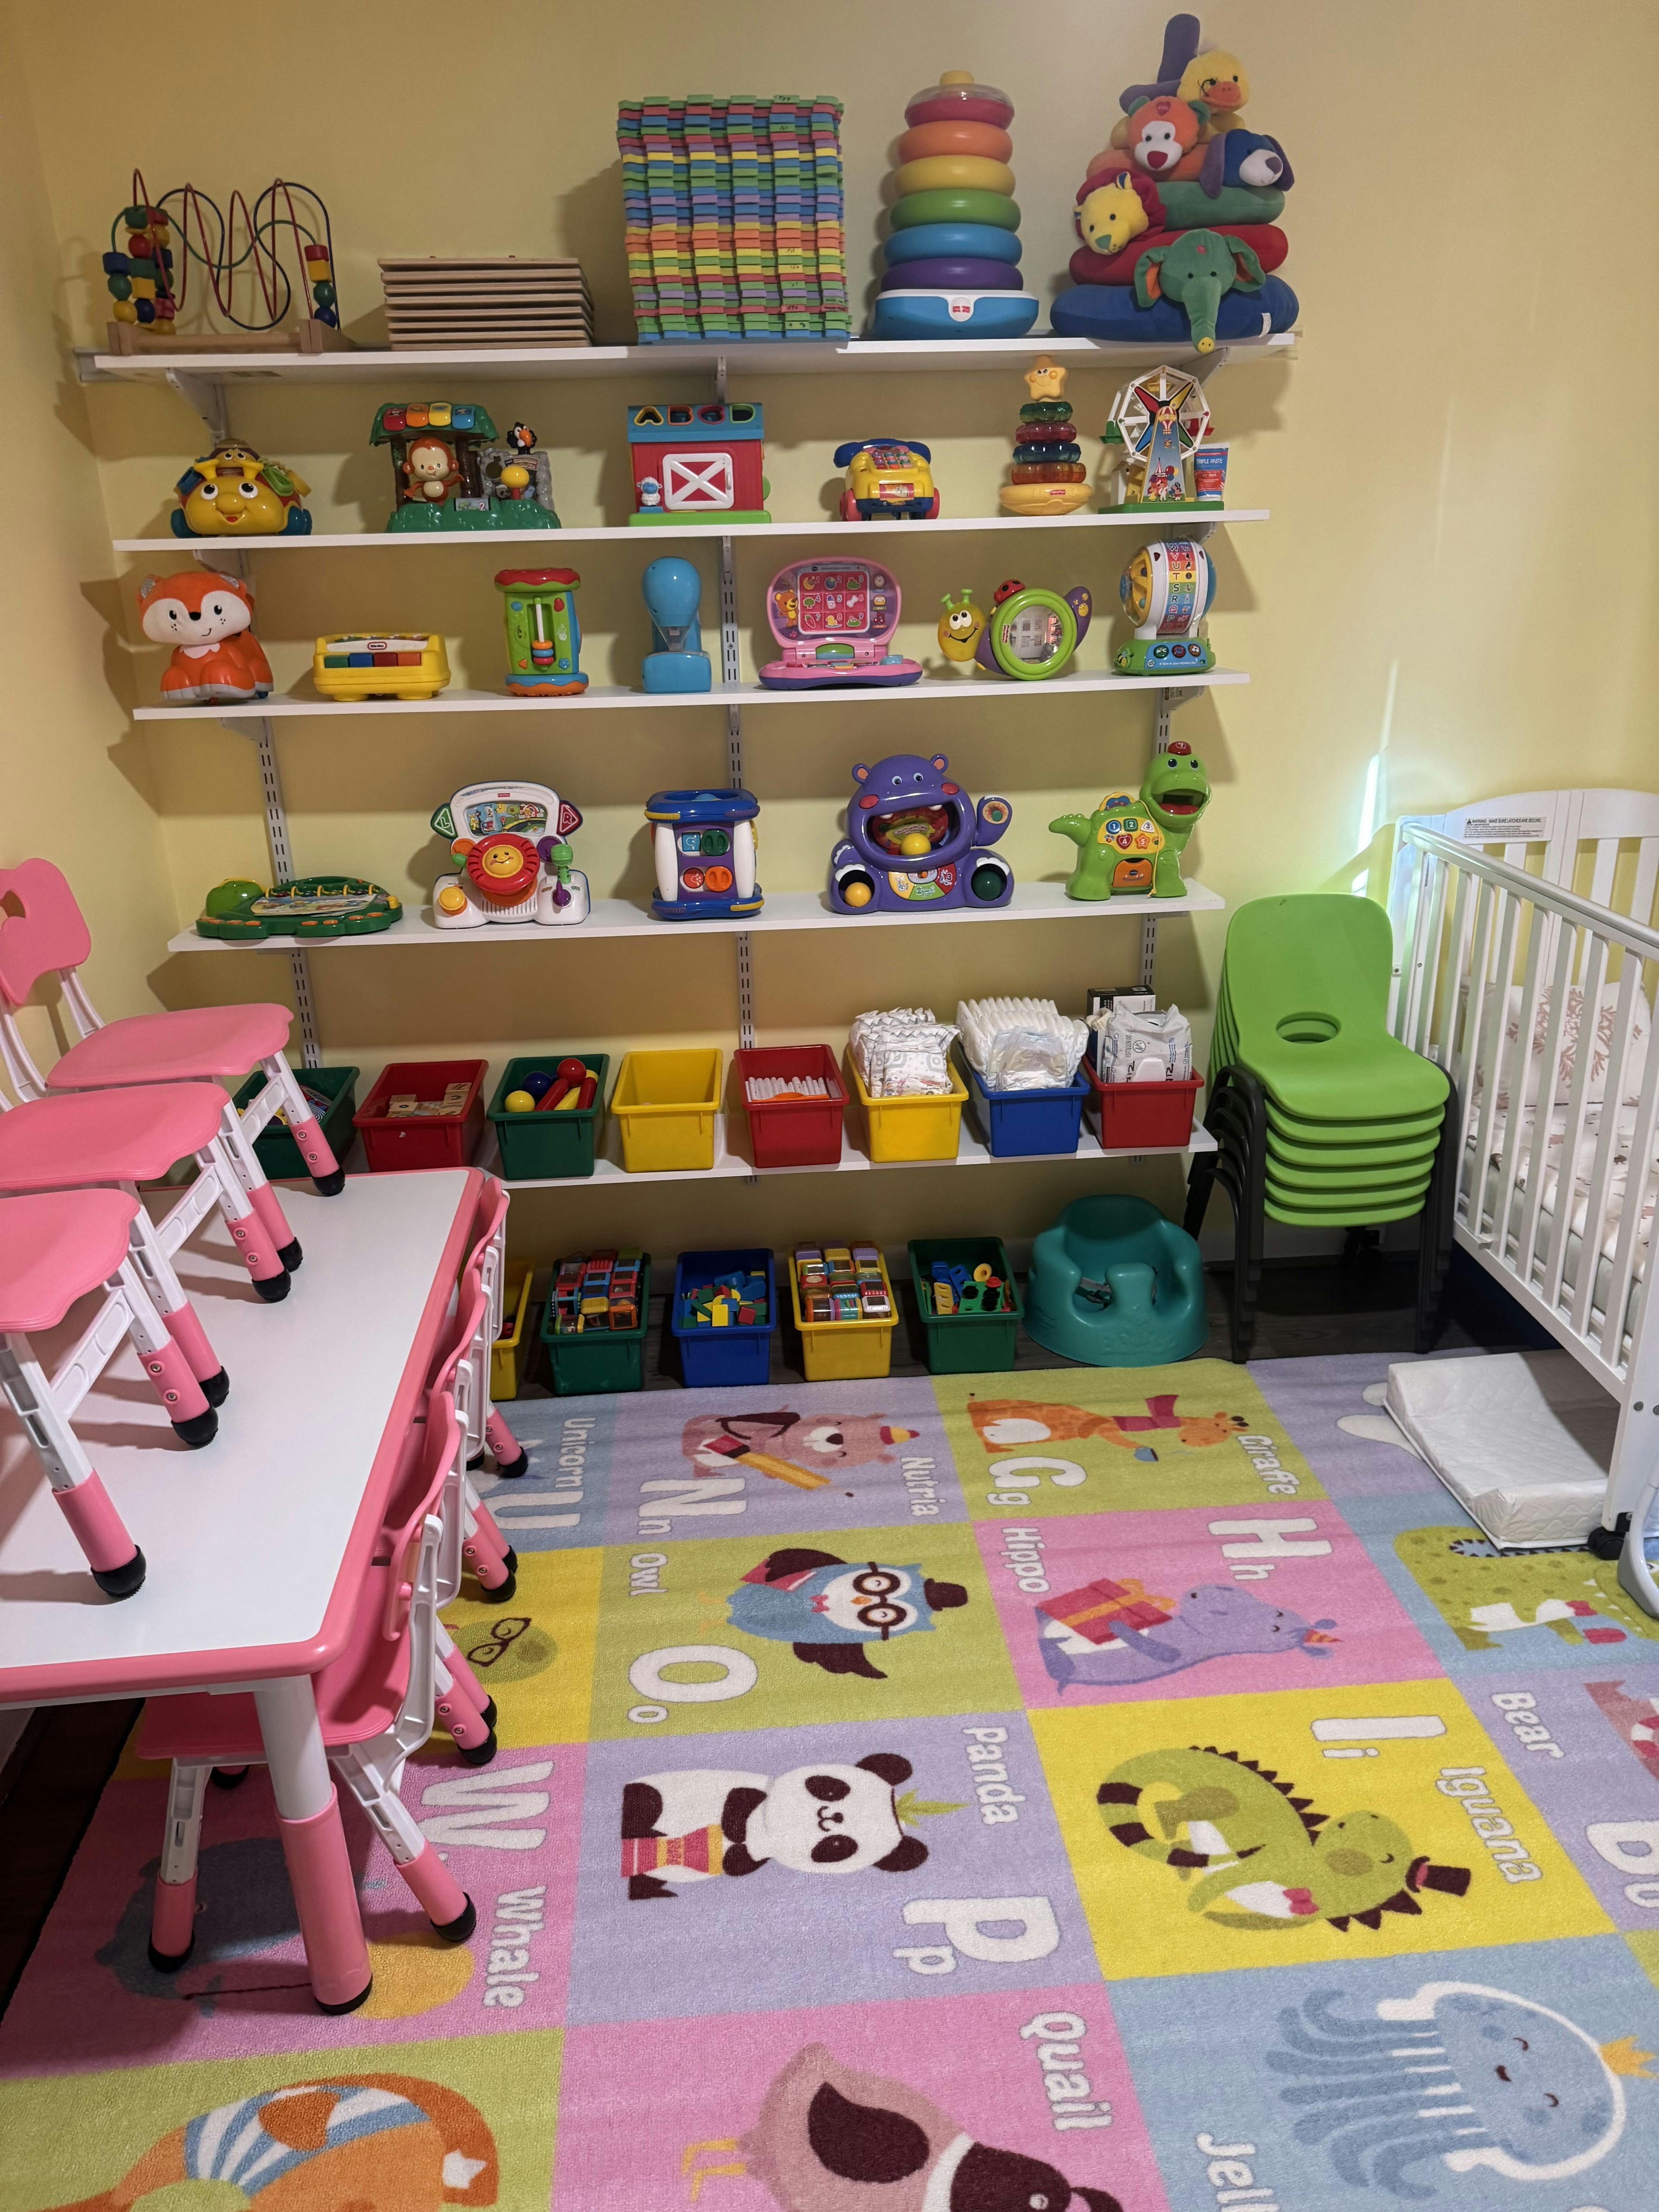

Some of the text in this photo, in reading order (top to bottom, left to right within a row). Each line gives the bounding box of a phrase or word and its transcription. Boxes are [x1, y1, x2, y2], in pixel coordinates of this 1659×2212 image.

[479, 503, 486, 511] 2
[1172, 562, 1180, 570] U
[1173, 583, 1180, 592] S
[1169, 605, 1178, 613] Q
[1171, 594, 1178, 604] R
[440, 817, 450, 828] L
[562, 812, 572, 824] R
[915, 886, 922, 895] 2
[555, 1417, 597, 1488] Unicorn
[1237, 1434, 1301, 1496] Giraffe
[900, 1456, 941, 1517] Nutria
[628, 1552, 668, 1597] Owl
[1000, 1526, 1051, 1594] Hippo
[1491, 1690, 1565, 1760] Bear
[962, 1725, 1027, 1826] Panda
[1436, 1765, 1543, 1884] Iguana
[483, 1884, 548, 2009] Whale
[1019, 2010, 1115, 2131] Quail
